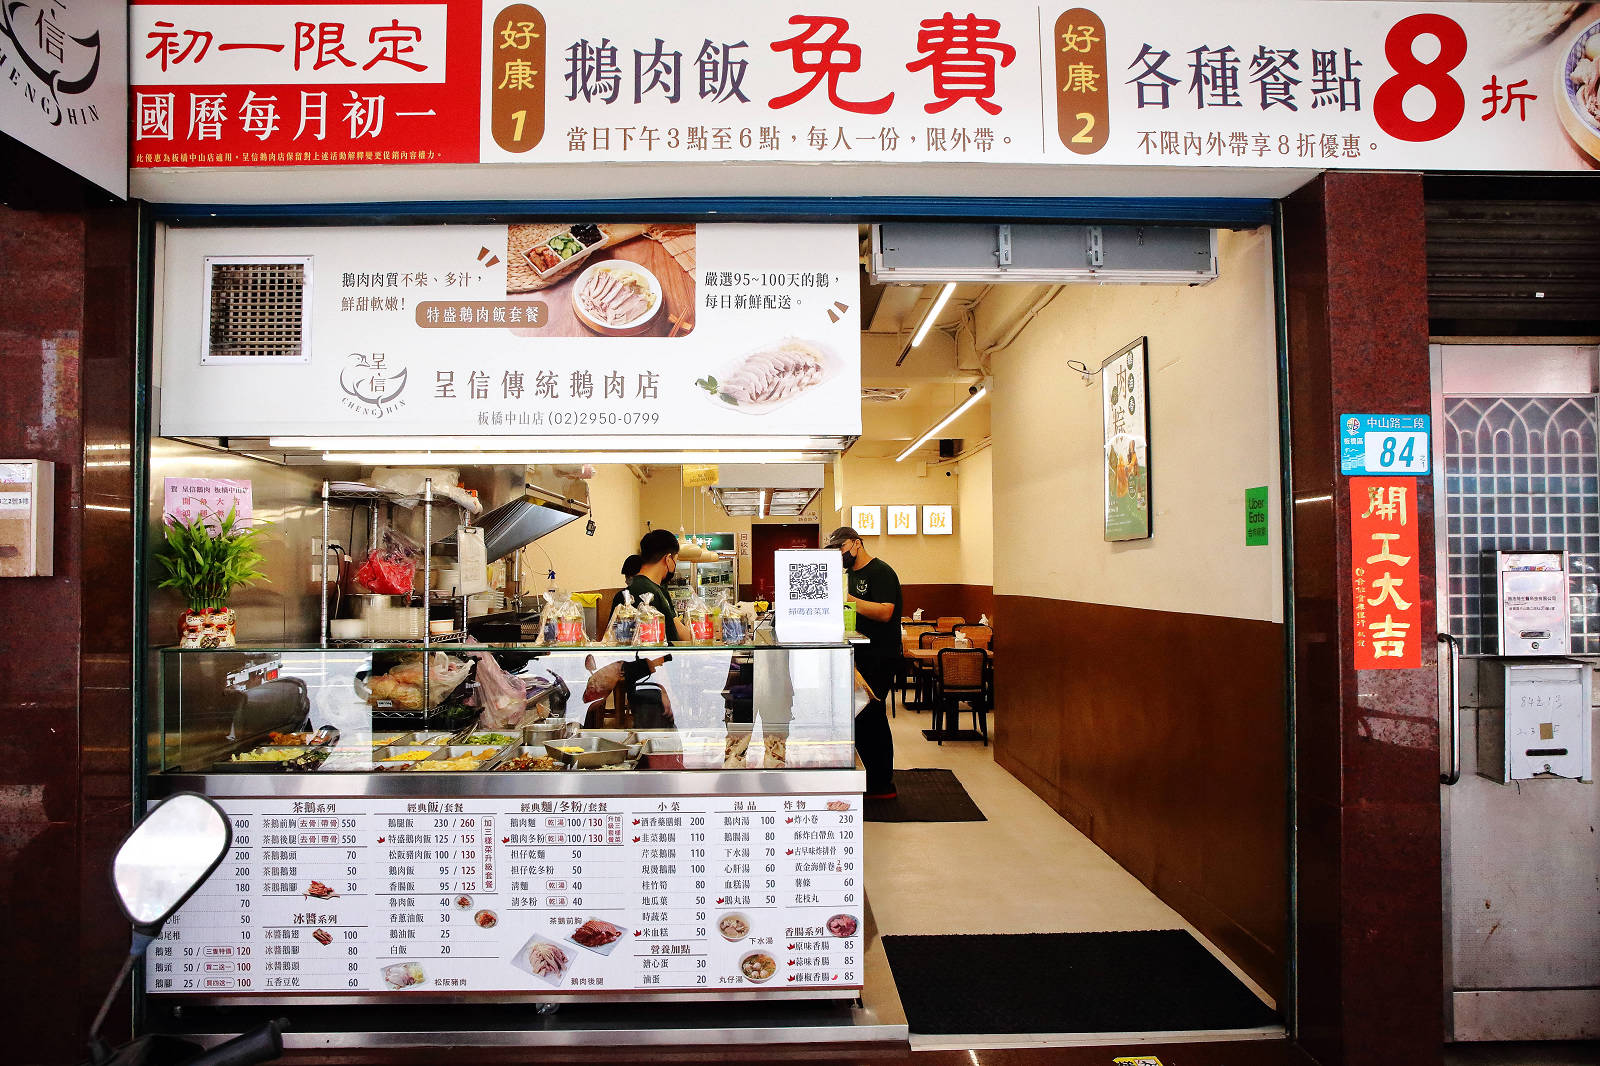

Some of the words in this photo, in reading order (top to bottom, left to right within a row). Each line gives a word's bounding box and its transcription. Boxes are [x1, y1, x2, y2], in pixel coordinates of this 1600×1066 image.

[35, 9, 66, 63] 信
[146, 19, 429, 72] 初一限定
[499, 20, 539, 91] 好康
[1062, 23, 1101, 95] 好康
[564, 38, 751, 106] 鵝肉飯
[767, 12, 1016, 116] 免費
[1125, 43, 1363, 113] 各種餐點
[1373, 13, 1468, 142] 8
[1481, 74, 1538, 122] 折
[136, 89, 436, 141] 國曆每月初一
[510, 110, 526, 142] 1
[1071, 113, 1094, 144] 2
[1137, 130, 1378, 159] 不限內外帶享8折優惠。
[705, 294, 802, 310] 每日新鮮配送。
[426, 306, 539, 323] 特盛鵝肉飯套餐
[434, 370, 661, 400] 呈信傳統鵝肉店
[477, 411, 544, 426] 板橋中山店
[548, 411, 660, 426] (02)2950-0799
[1367, 417, 1424, 429] 中山路二段
[1380, 437, 1415, 467] 84
[894, 512, 909, 529] 肉
[929, 512, 945, 528] 飯
[1249, 512, 1264, 523] Eats
[1361, 486, 1412, 659] 開工大吉
[292, 802, 335, 813] 茶鵝系列
[342, 819, 356, 827] 550
[434, 819, 448, 827] 230
[461, 819, 474, 827] 260
[567, 819, 581, 827] 100
[589, 818, 602, 826] 130
[690, 817, 704, 825] 200
[724, 817, 750, 826] 鵝肉湯
[761, 816, 774, 824] 100
[839, 815, 853, 823] 230
[235, 820, 249, 828] 400
[342, 835, 356, 843] 550
[435, 835, 448, 843] 125
[461, 835, 474, 843] 155
[589, 834, 602, 842] 130
[691, 833, 704, 841] 110
[765, 832, 775, 840] 80
[840, 831, 853, 839] 120
[235, 836, 249, 844] 400
[236, 852, 249, 860] 200
[347, 851, 356, 859] 70
[435, 851, 449, 859] 100
[461, 851, 475, 859] 130
[572, 850, 581, 858] 50
[691, 849, 705, 857] 110
[725, 848, 750, 857] 下水湯
[766, 848, 775, 856] 70
[236, 868, 249, 876] 200
[347, 867, 356, 875] 50
[389, 866, 415, 875] 鵝肉飯
[691, 865, 705, 873] 100
[725, 864, 750, 873] 心肝湯
[766, 864, 775, 872] 60
[440, 882, 449, 890] 95
[462, 882, 475, 890] 125
[766, 880, 775, 888] 50
[844, 878, 853, 886] 60
[236, 884, 249, 892] 180
[348, 883, 357, 891] 30
[440, 898, 449, 906] 40
[642, 896, 668, 905] 地瓜葉
[844, 894, 853, 902] 60
[241, 899, 250, 907] 70
[241, 915, 250, 923] 50
[293, 913, 337, 924] 冰醬系列
[441, 914, 450, 922] 30
[696, 912, 705, 920] 50
[241, 931, 250, 939] 10
[344, 931, 357, 939] 100
[441, 930, 450, 938] 25
[643, 928, 668, 937] 米血糕
[697, 928, 705, 936] 50
[845, 941, 853, 949] 85
[184, 948, 193, 956] 50
[237, 947, 250, 955] 120
[348, 947, 357, 955] 80
[237, 963, 251, 971] 100
[349, 963, 358, 971] 80
[845, 972, 853, 980] 85
[237, 979, 251, 987] 100
[349, 979, 358, 987] 60
